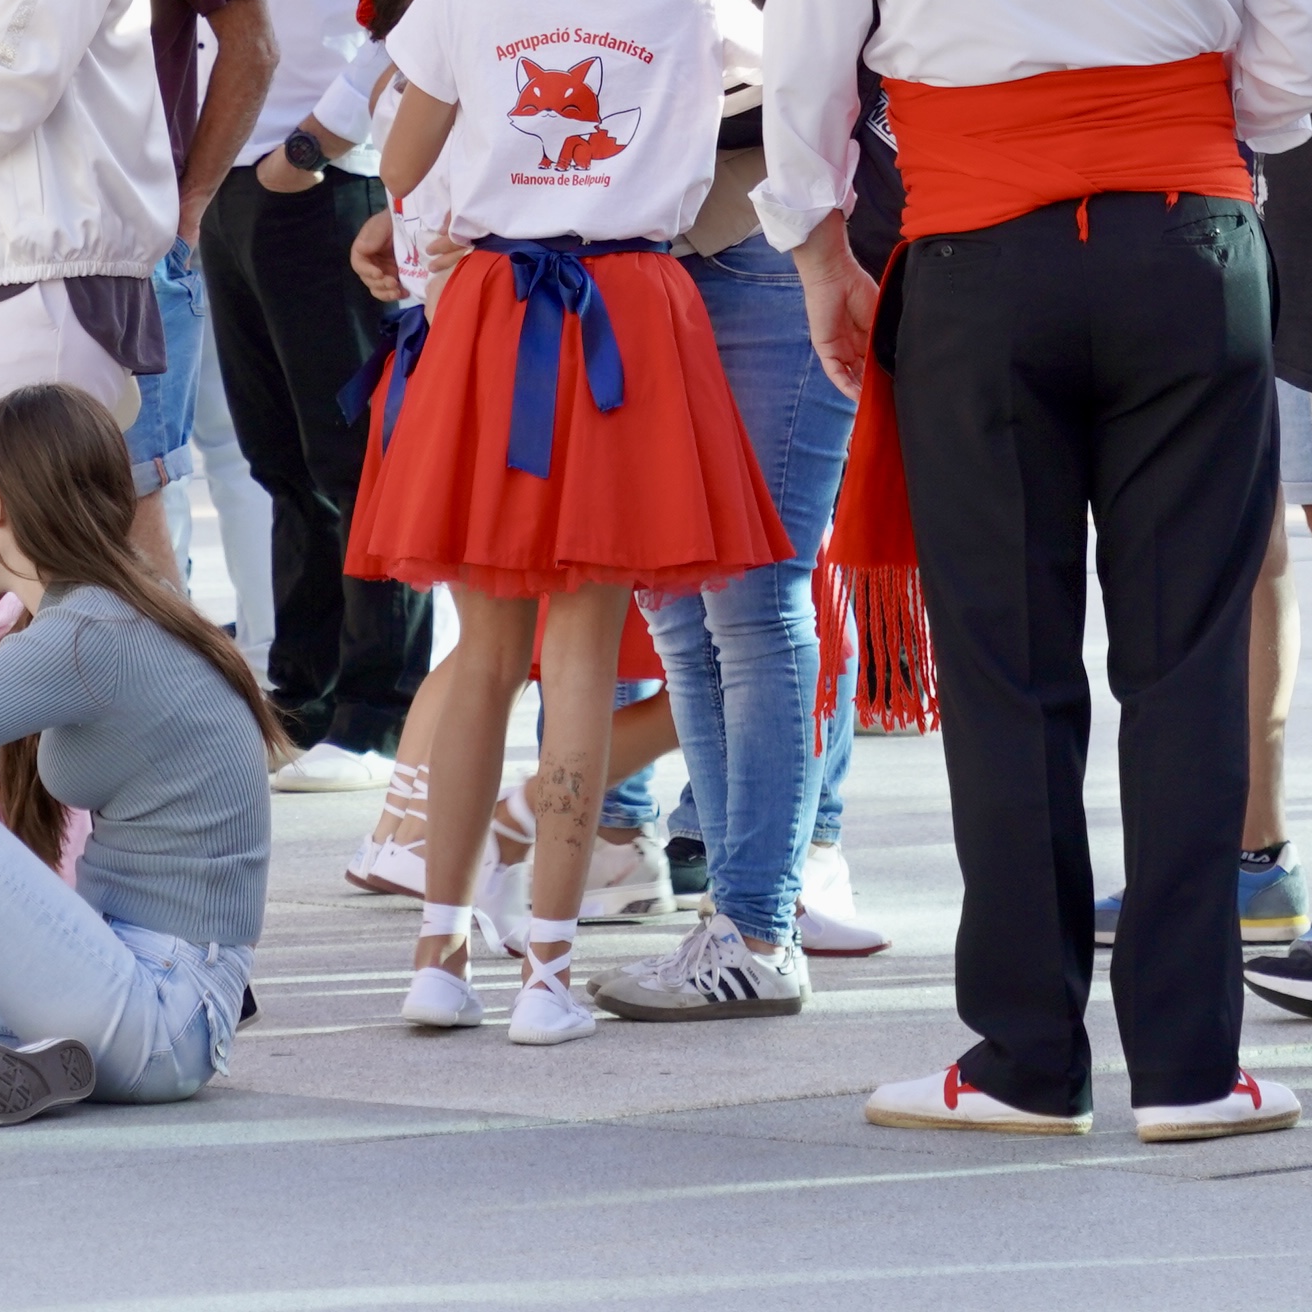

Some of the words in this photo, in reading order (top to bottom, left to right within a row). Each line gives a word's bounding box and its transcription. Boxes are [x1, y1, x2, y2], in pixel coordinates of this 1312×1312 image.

[495, 27, 570, 61] Agrupació
[573, 27, 655, 65] Sardanista
[510, 173, 555, 186] Vilanova
[557, 174, 570, 186] de
[572, 173, 611, 188] Bellpuig
[1240, 851, 1271, 863] ILA
